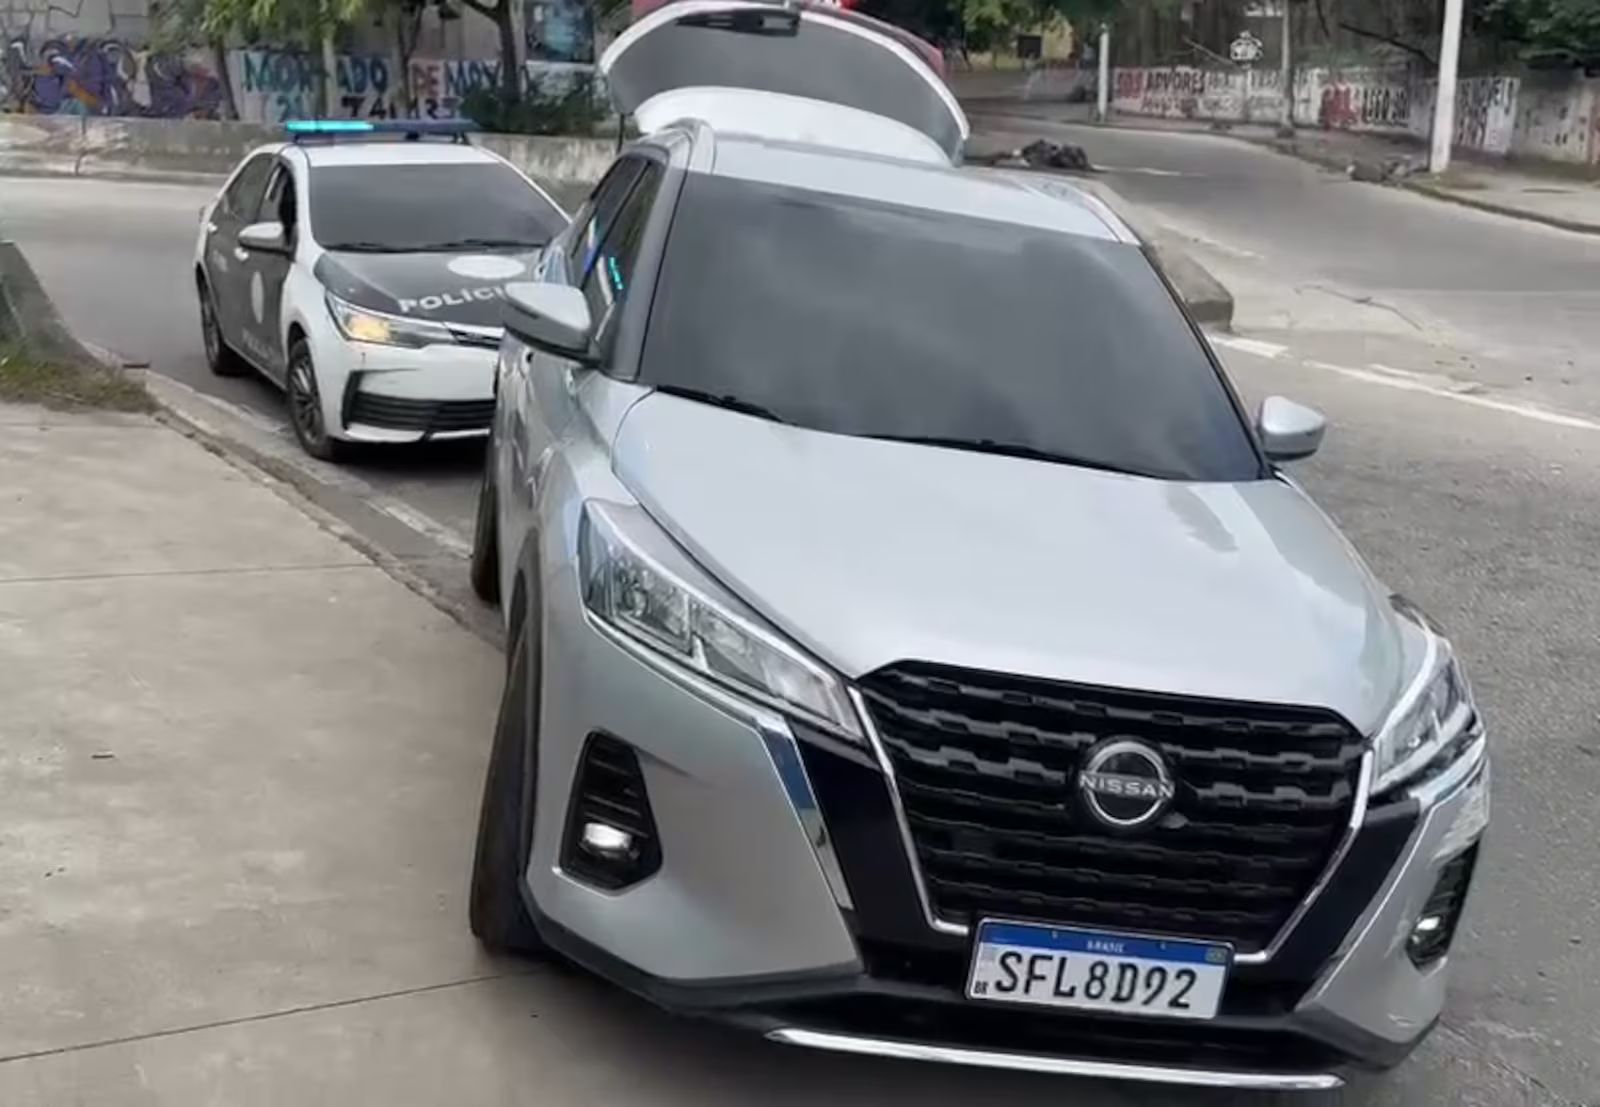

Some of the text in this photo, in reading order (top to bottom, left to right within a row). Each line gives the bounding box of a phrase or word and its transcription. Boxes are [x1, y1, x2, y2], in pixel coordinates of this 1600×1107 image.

[1080, 772, 1175, 799] NISSAN
[1087, 940, 1124, 953] BRASIL
[974, 980, 989, 995] BR
[994, 951, 1197, 1009] SFL8D92
